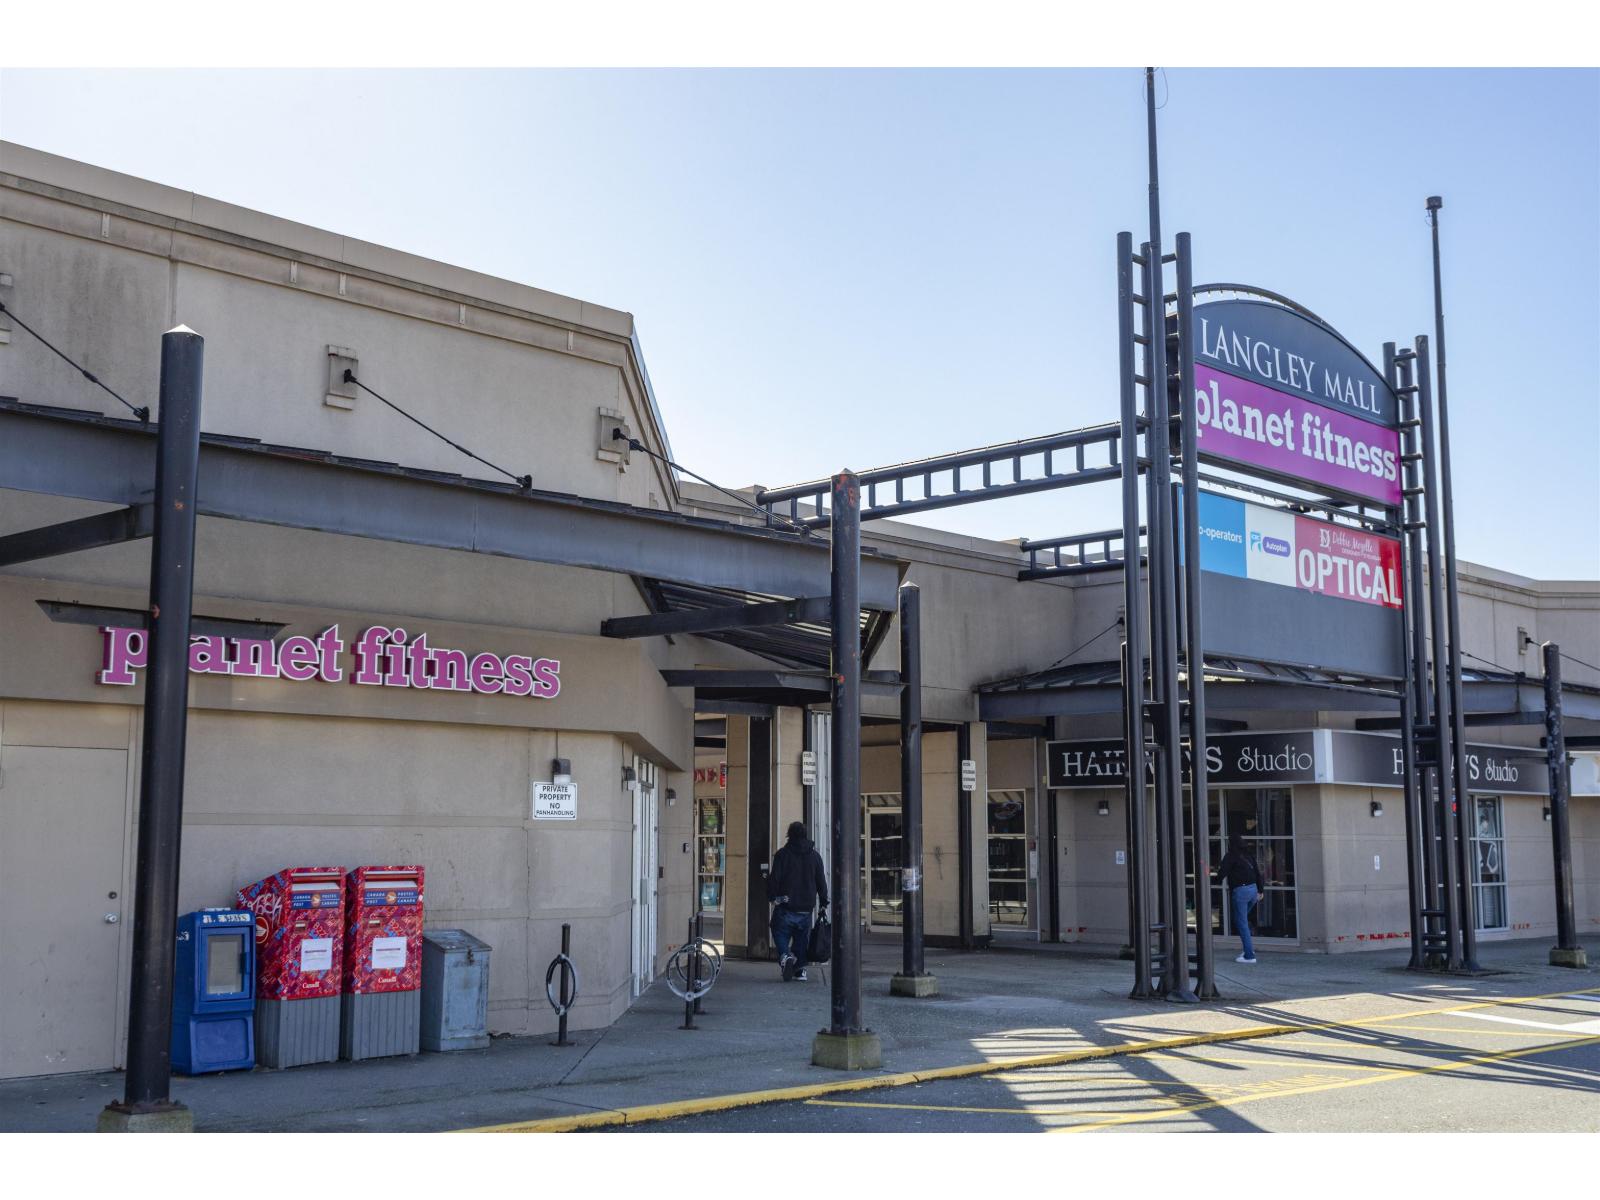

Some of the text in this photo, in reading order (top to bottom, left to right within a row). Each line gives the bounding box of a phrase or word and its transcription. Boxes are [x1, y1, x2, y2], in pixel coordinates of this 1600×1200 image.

[1200, 318, 1381, 414] LANGLEY MALL
[1195, 380, 1397, 482] planet fitness
[1298, 548, 1402, 606] OPTICAL
[99, 623, 561, 699] panet fitness
[1237, 743, 1313, 772] Studio
[1484, 758, 1519, 783] Studio
